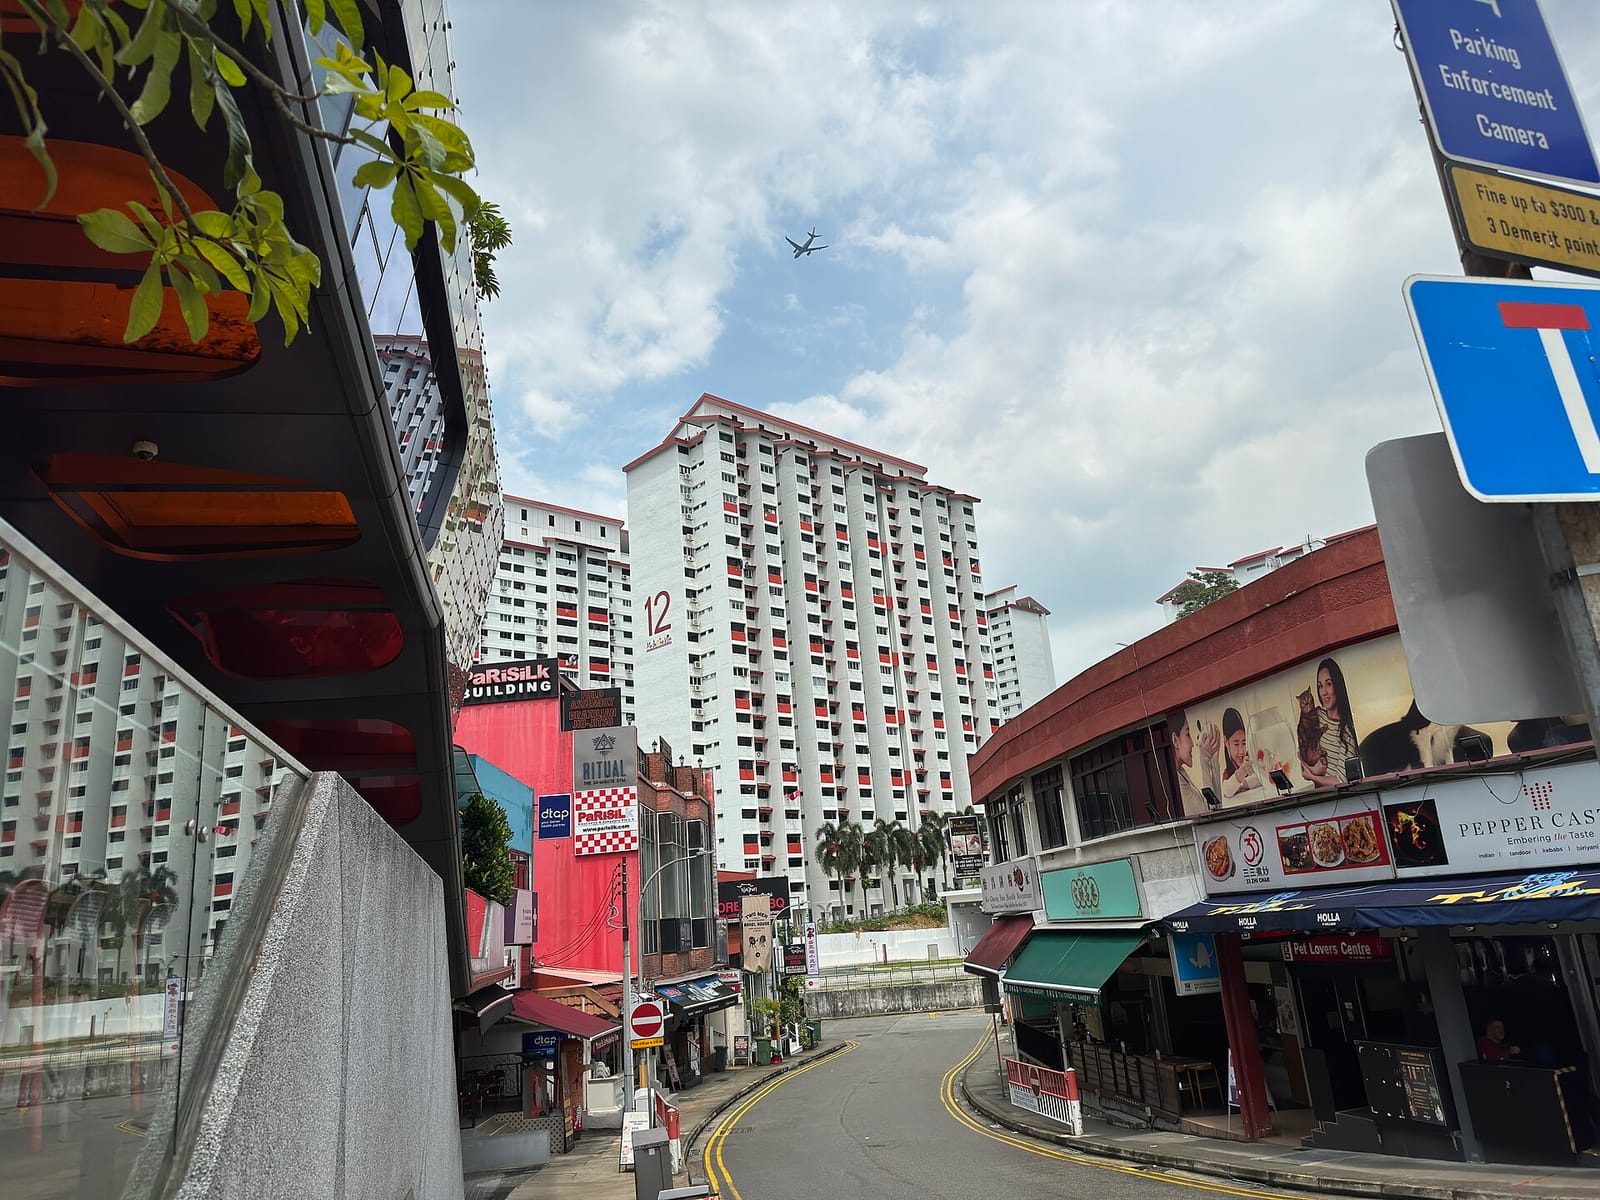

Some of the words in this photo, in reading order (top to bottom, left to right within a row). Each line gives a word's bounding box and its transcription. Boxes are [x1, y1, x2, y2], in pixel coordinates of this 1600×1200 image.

[1449, 28, 1521, 69] Parking
[1439, 64, 1557, 111] Enforcement
[1476, 114, 1549, 149] Camera
[1475, 183, 1507, 205] Fine
[1511, 195, 1528, 213] up
[1531, 196, 1547, 213] to
[1550, 200, 1586, 222] $300
[1487, 217, 1496, 234] 3
[1500, 220, 1560, 248] Demerit
[644, 590, 672, 637] 12
[583, 760, 626, 780] RITUAL
[541, 808, 569, 820] dtap
[1459, 815, 1543, 837] PEPPER
[1507, 834, 1552, 846] Embering
[1554, 831, 1568, 841] the
[1569, 830, 1595, 840] Taste
[1509, 849, 1531, 857] tandoor
[745, 911, 757, 919] TWO
[1238, 916, 1258, 927] HOLLA
[1317, 912, 1341, 923] HOLLA
[1293, 942, 1307, 955] Pet
[1309, 942, 1338, 955] Lovers
[1341, 941, 1371, 955] Centre
[534, 1036, 556, 1045] dtap
